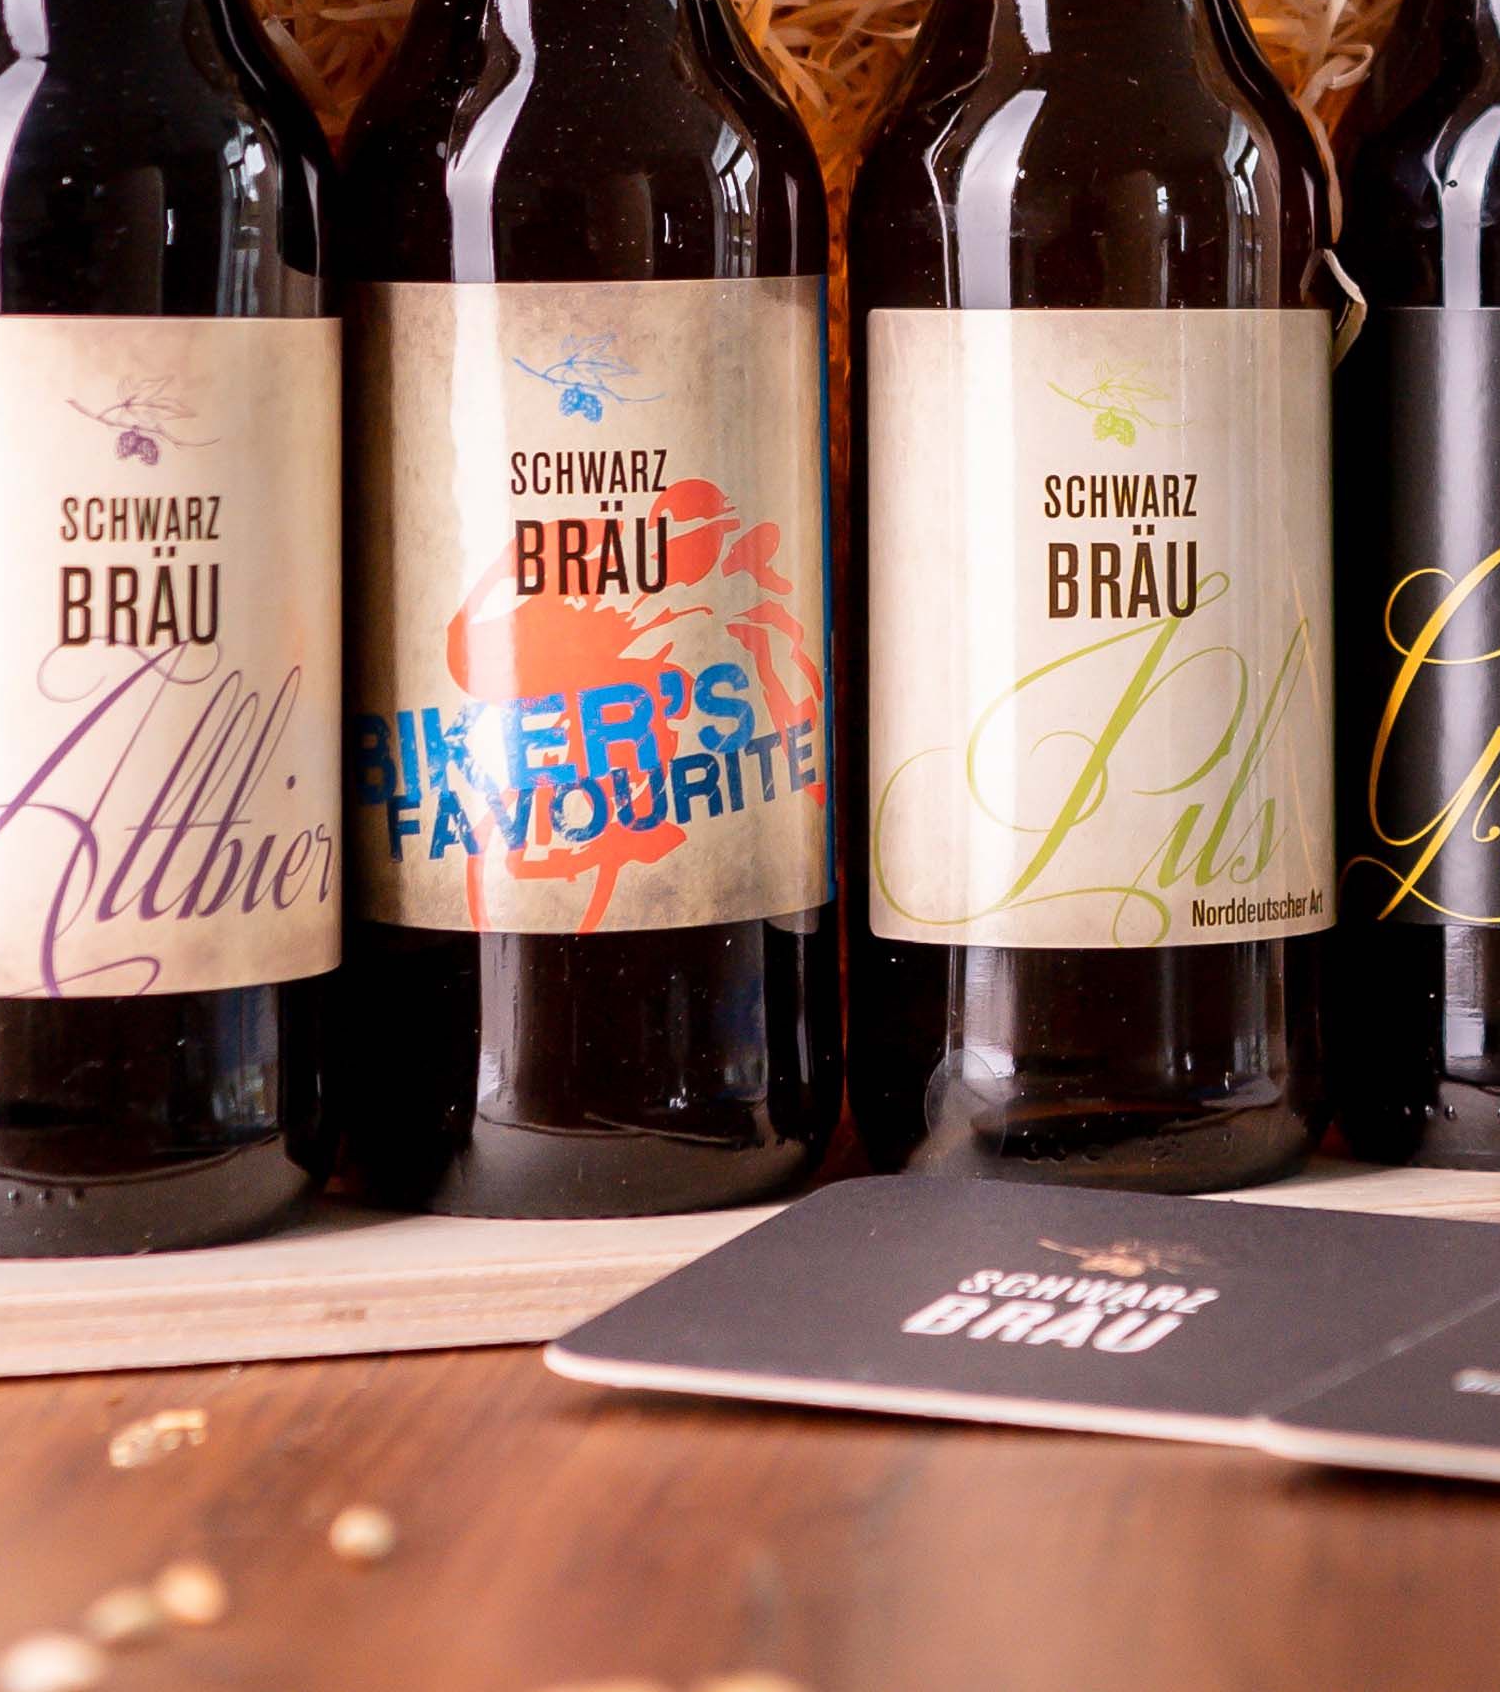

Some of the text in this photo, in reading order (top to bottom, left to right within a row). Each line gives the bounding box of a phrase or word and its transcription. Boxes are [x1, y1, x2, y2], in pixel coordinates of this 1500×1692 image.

[510, 449, 668, 495] SCHWARZ
[1044, 473, 1198, 519] SCHWARZ
[60, 496, 221, 542] SCHWARZ
[515, 500, 669, 596] BRÄU
[61, 547, 221, 647] BRÄU
[1047, 524, 1198, 620] BRÄU
[352, 662, 756, 805] BIKER'S
[873, 571, 1309, 948] Pils
[387, 720, 817, 861] FAVOURITE
[1192, 892, 1307, 927] Norddeutscher
[901, 1292, 1184, 1355] BRÄU
[957, 1268, 1221, 1315] SCHWARZ
